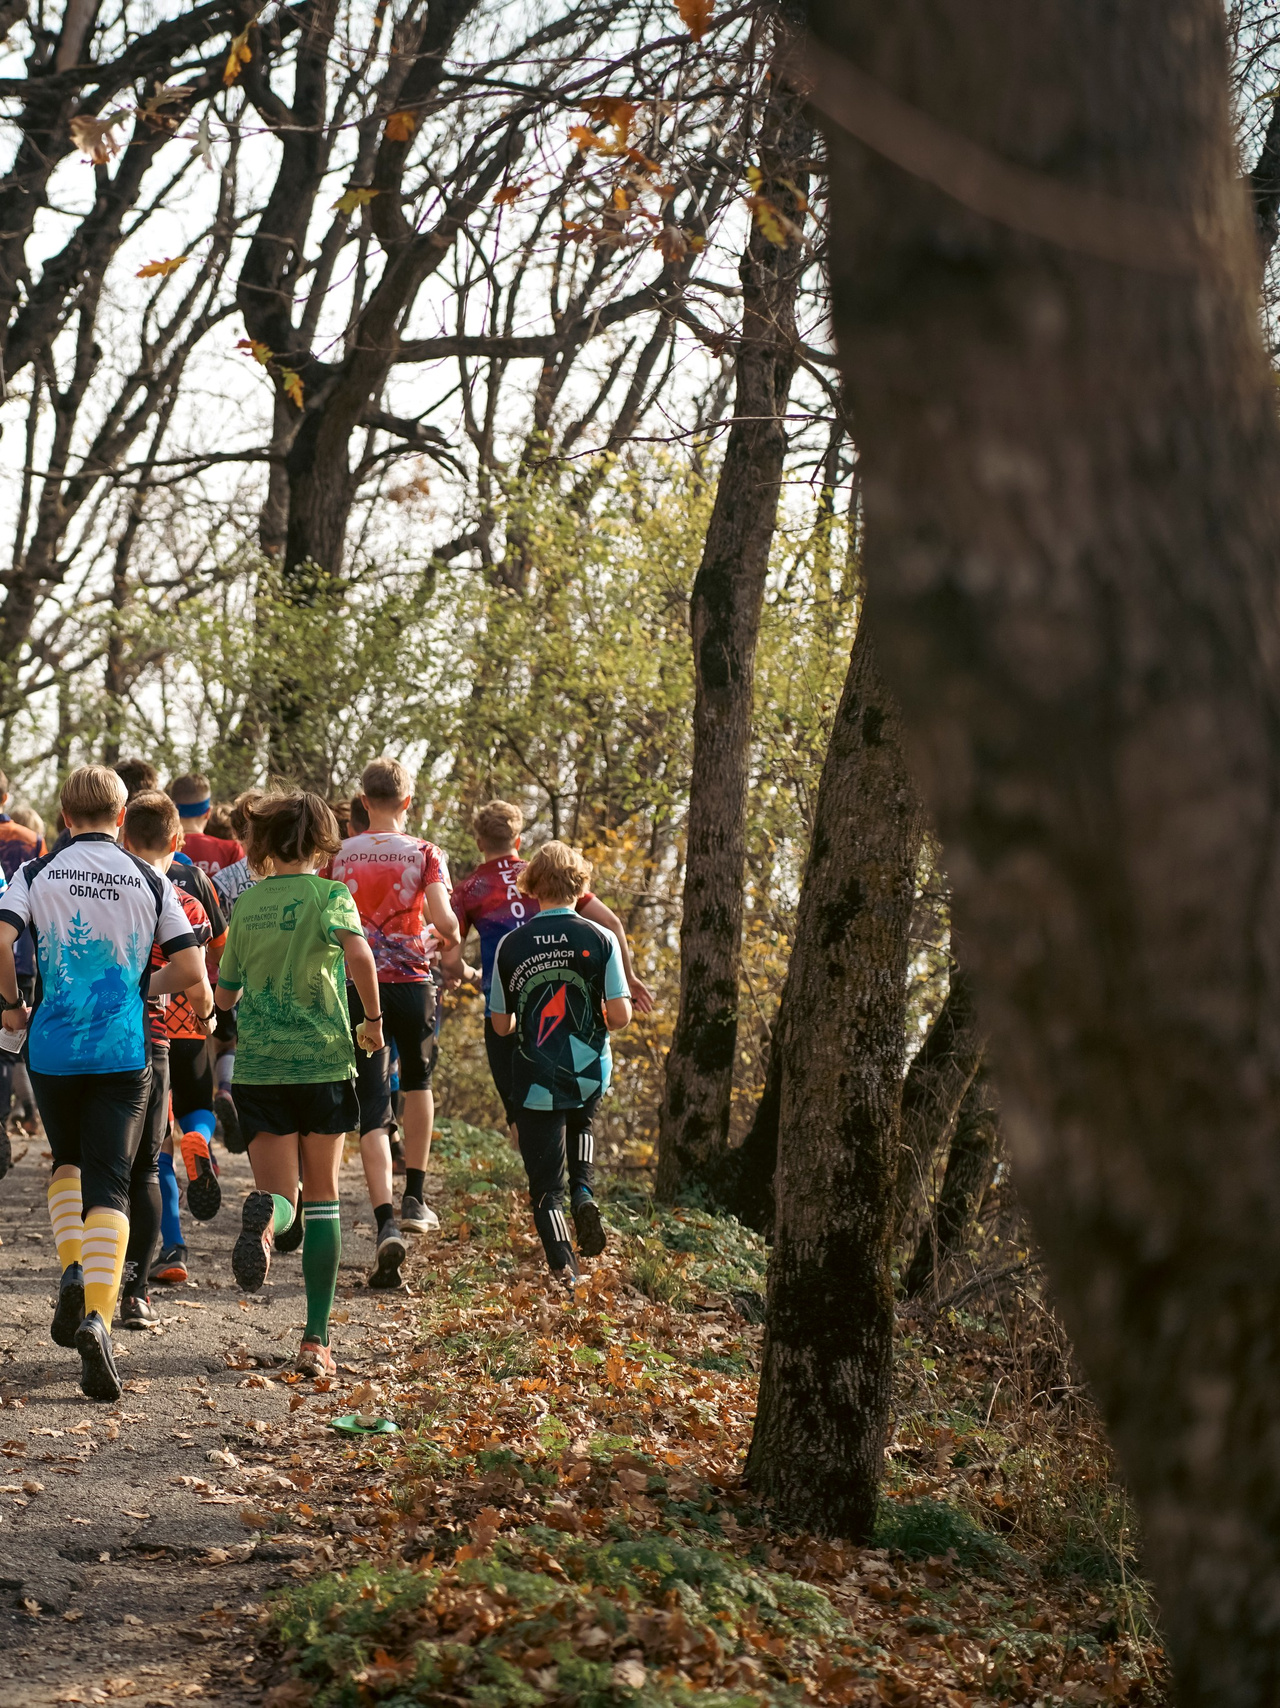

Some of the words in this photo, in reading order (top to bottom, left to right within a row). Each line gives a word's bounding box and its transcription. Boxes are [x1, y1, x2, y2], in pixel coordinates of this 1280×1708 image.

[341, 853, 416, 867] МОРДОВИЯ
[47, 869, 141, 889] ЛЕНИНГРАДСКАЯ
[69, 884, 120, 901] ОБЛАСТЬ
[533, 933, 569, 945] TULA
[508, 949, 575, 992] ОРИЕНТИРУЙСЯ
[515, 976, 526, 991] НА
[525, 960, 569, 978] ПОБЕДУ!
